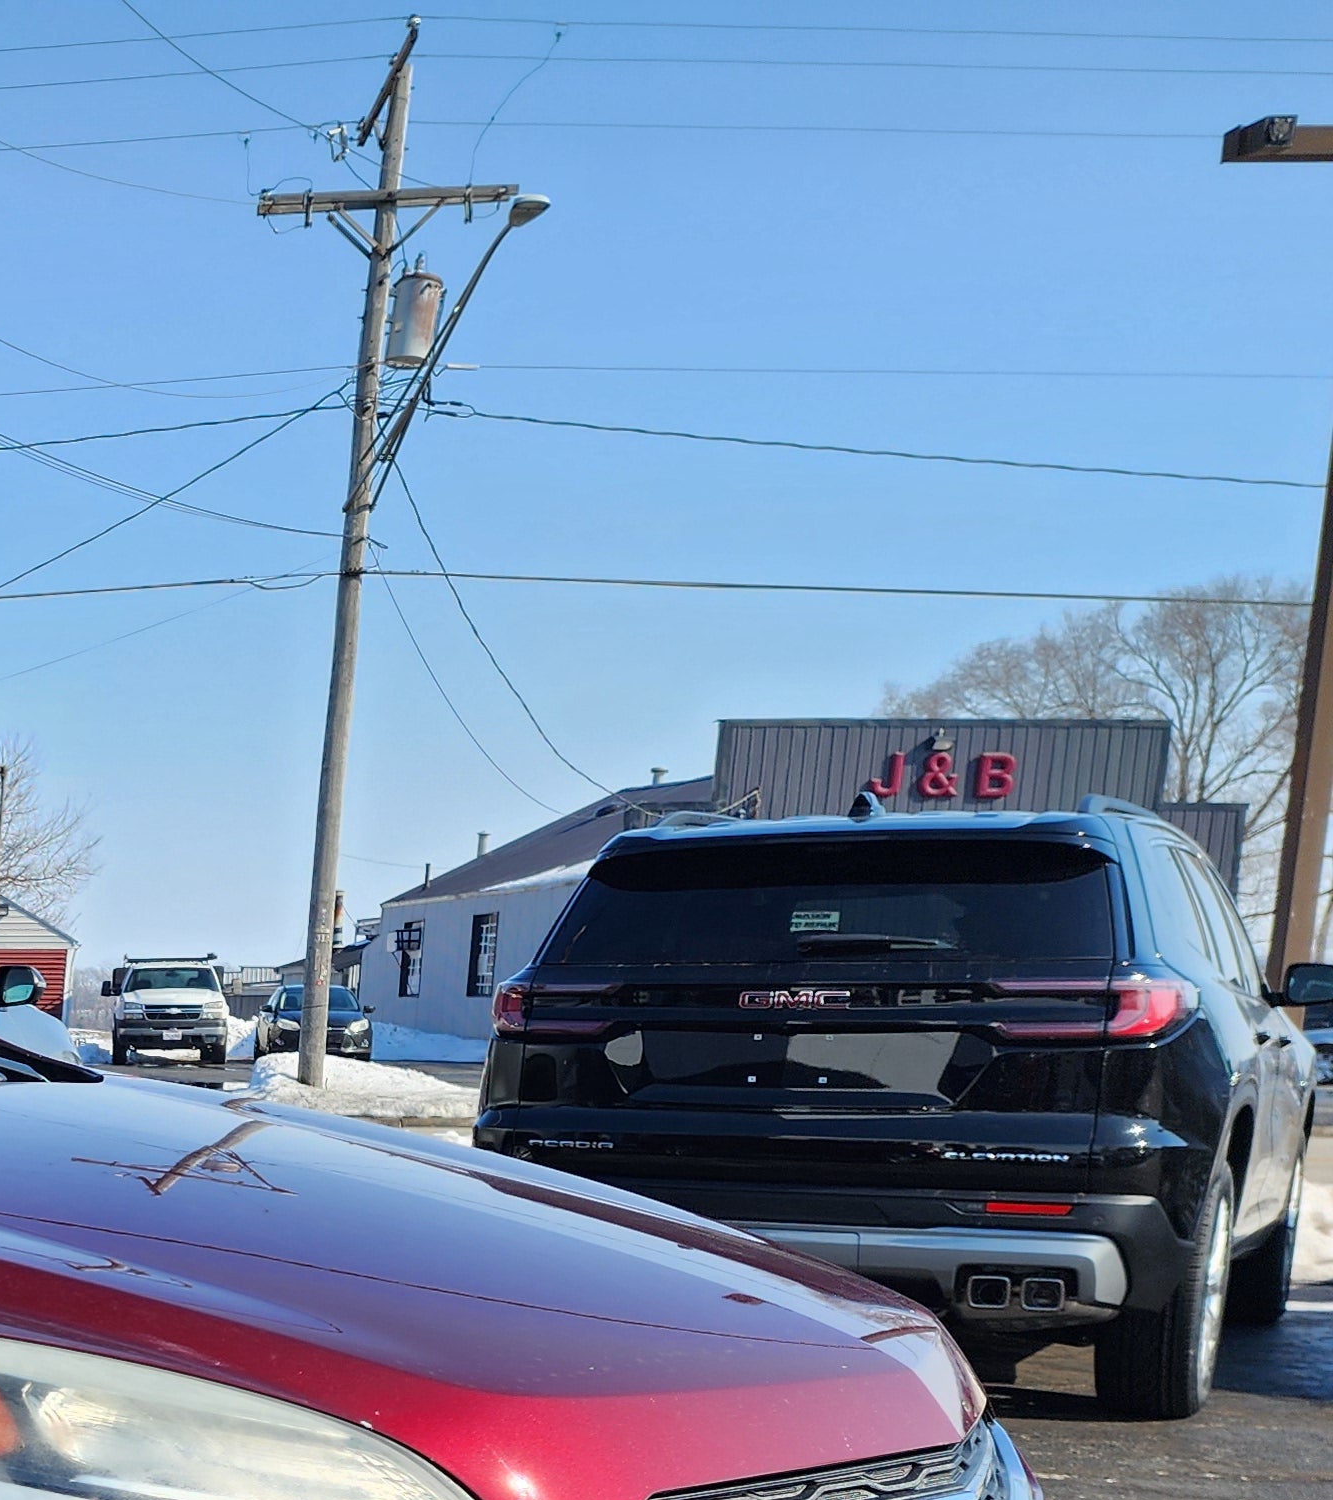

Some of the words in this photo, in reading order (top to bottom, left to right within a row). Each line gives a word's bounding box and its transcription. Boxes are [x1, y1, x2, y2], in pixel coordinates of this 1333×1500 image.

[870, 751, 905, 798] J
[917, 751, 958, 797] &
[976, 752, 1017, 798] B
[739, 990, 851, 1009] GMC
